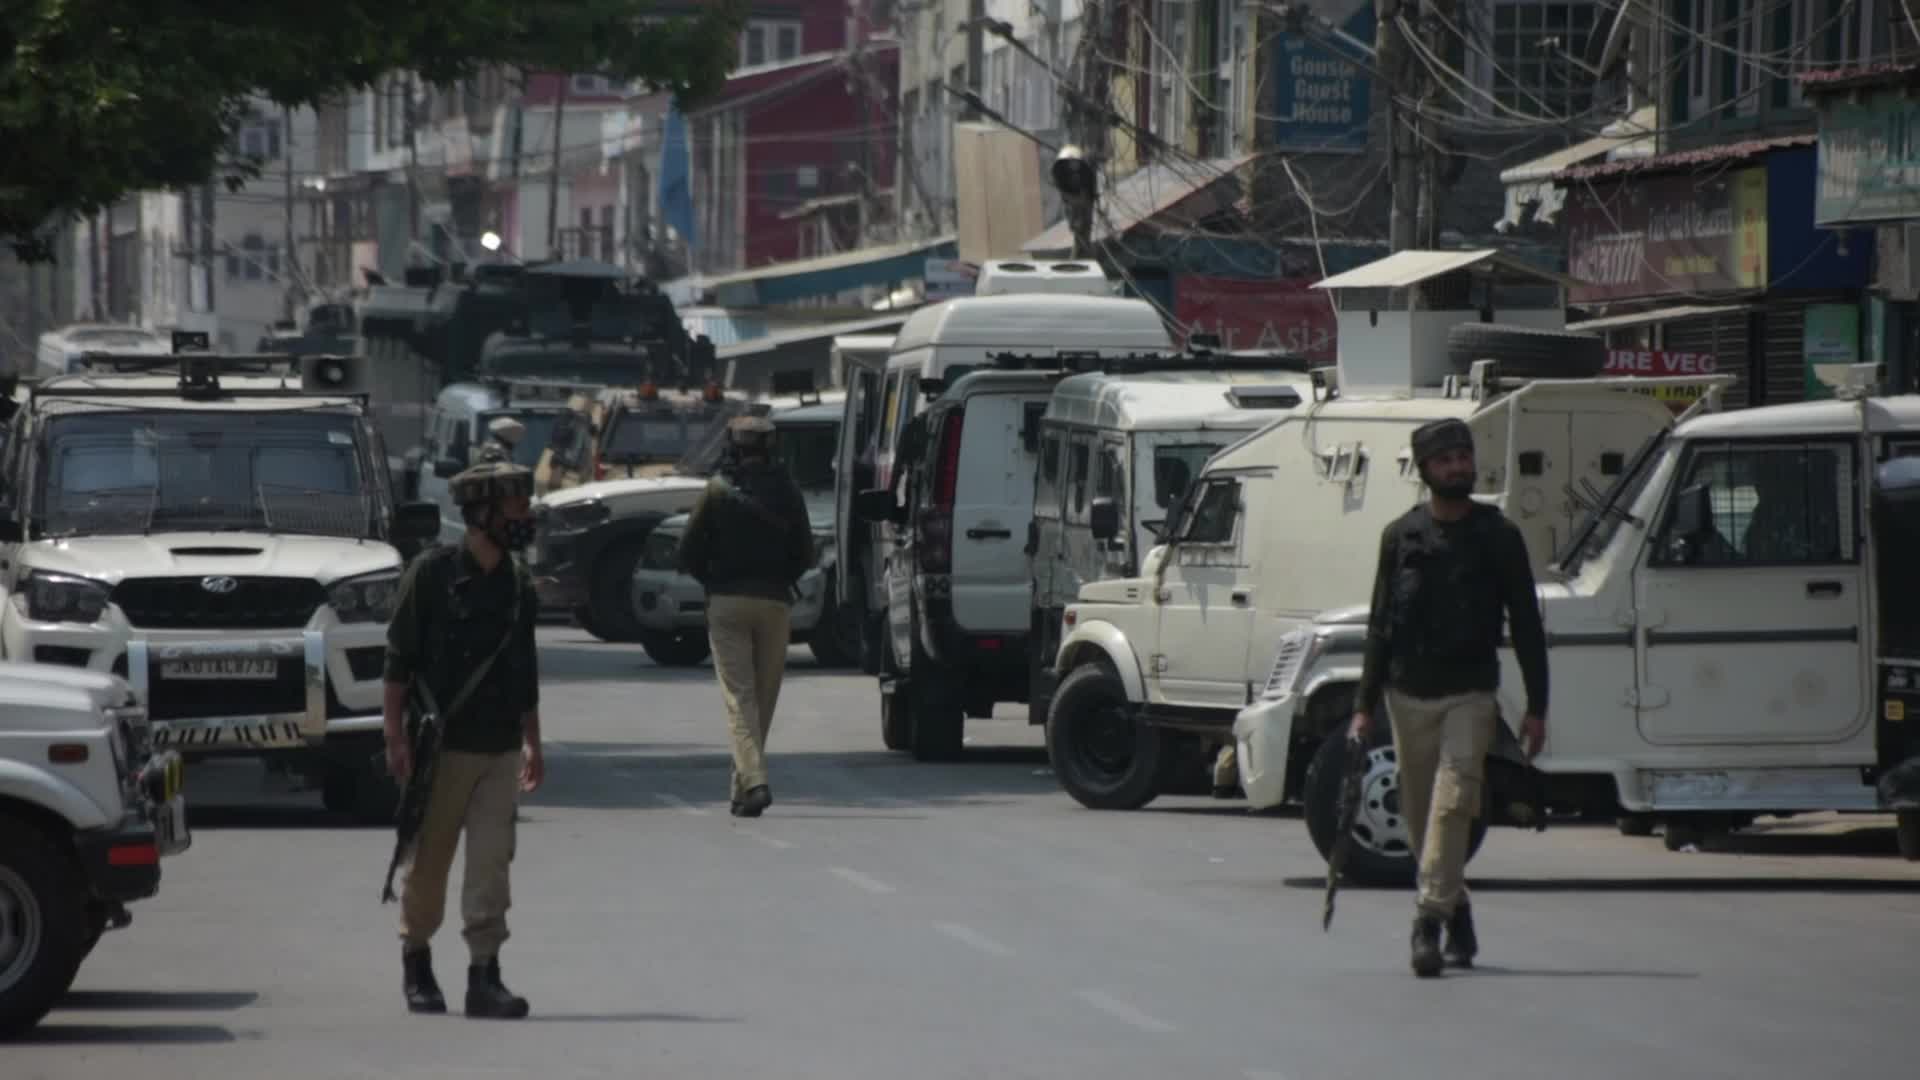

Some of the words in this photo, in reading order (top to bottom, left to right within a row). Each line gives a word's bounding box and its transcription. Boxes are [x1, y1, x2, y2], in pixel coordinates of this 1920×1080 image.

[1295, 79, 1352, 98] Guest
[1293, 102, 1352, 123] House
[1256, 319, 1329, 353] Asia
